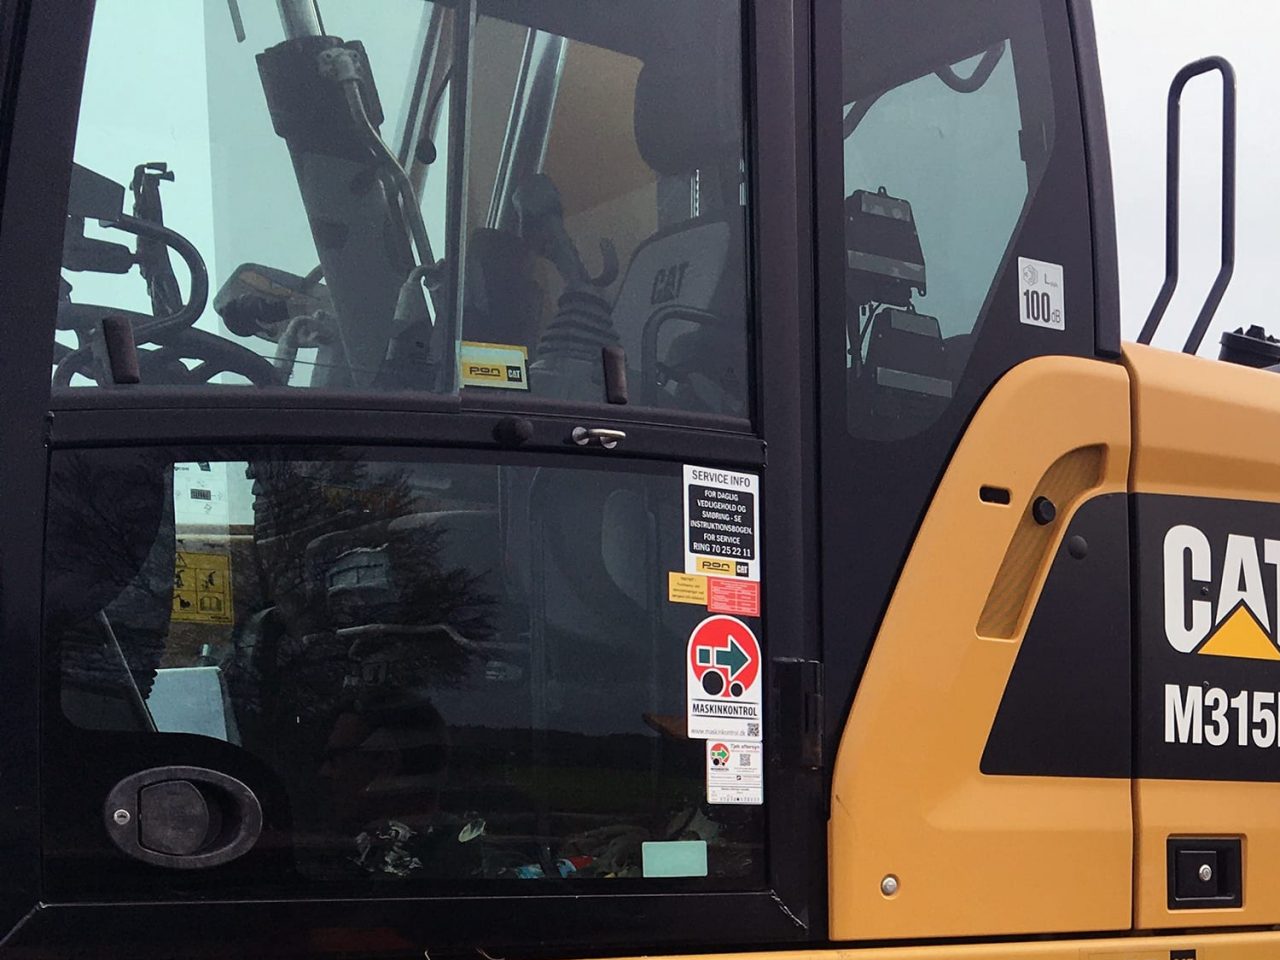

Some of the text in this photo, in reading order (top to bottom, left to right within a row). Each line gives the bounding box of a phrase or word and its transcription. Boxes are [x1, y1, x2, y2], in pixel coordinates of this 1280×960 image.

[651, 261, 690, 304] CAT
[1024, 289, 1061, 323] 100 dB
[508, 369, 520, 378] CAT
[692, 470, 751, 488] SERVICE INFO
[704, 490, 739, 501] FOR DAGLIG
[697, 499, 746, 513] VEDLIGEHOLD OG
[702, 511, 730, 521] SMØRING
[703, 533, 740, 544] FOR SERVICE
[693, 542, 751, 557] RING 70 25 22 11
[702, 561, 748, 574] pon CAT
[692, 703, 758, 716] MASKINKONTROL
